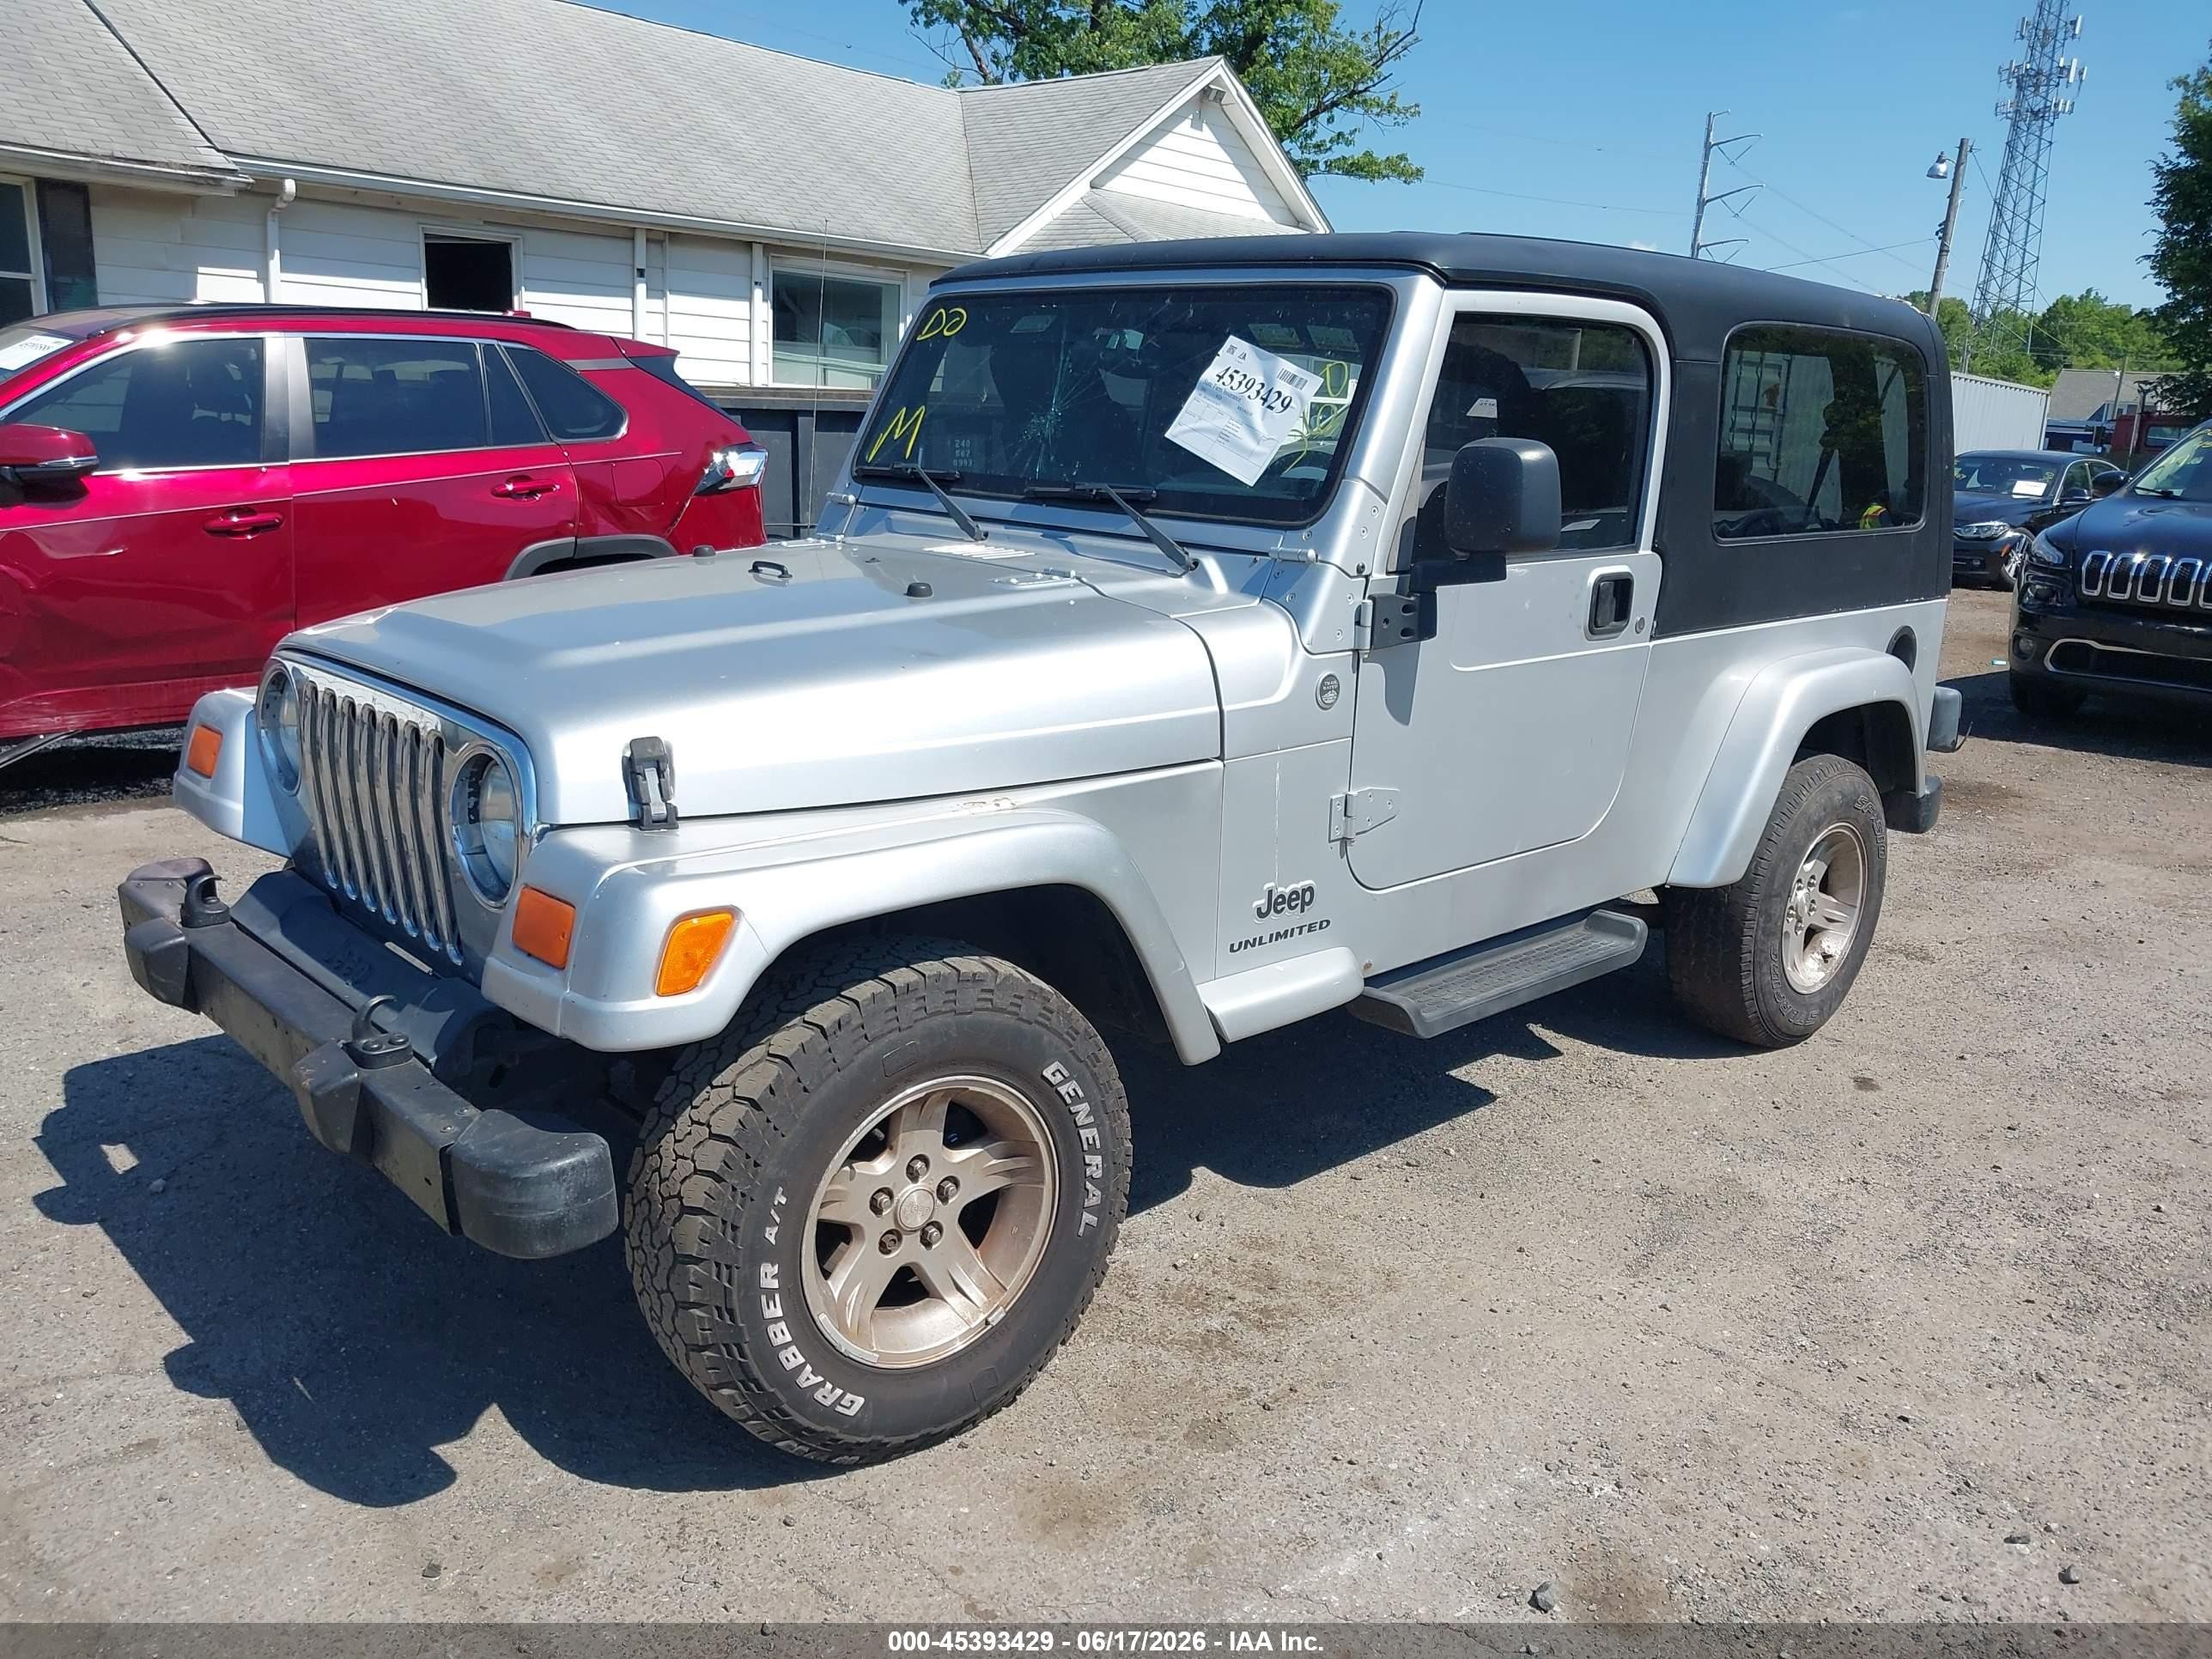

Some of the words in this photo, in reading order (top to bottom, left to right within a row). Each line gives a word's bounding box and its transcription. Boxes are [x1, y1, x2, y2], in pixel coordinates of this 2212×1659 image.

[1215, 366, 1293, 414] 45393429
[1255, 884, 1316, 920] Jeep
[1229, 919, 1331, 953] UNLIMITED
[1041, 1060, 1104, 1238] GENERAL
[763, 1186, 788, 1247] A/T
[759, 1262, 866, 1418] GRABBER
